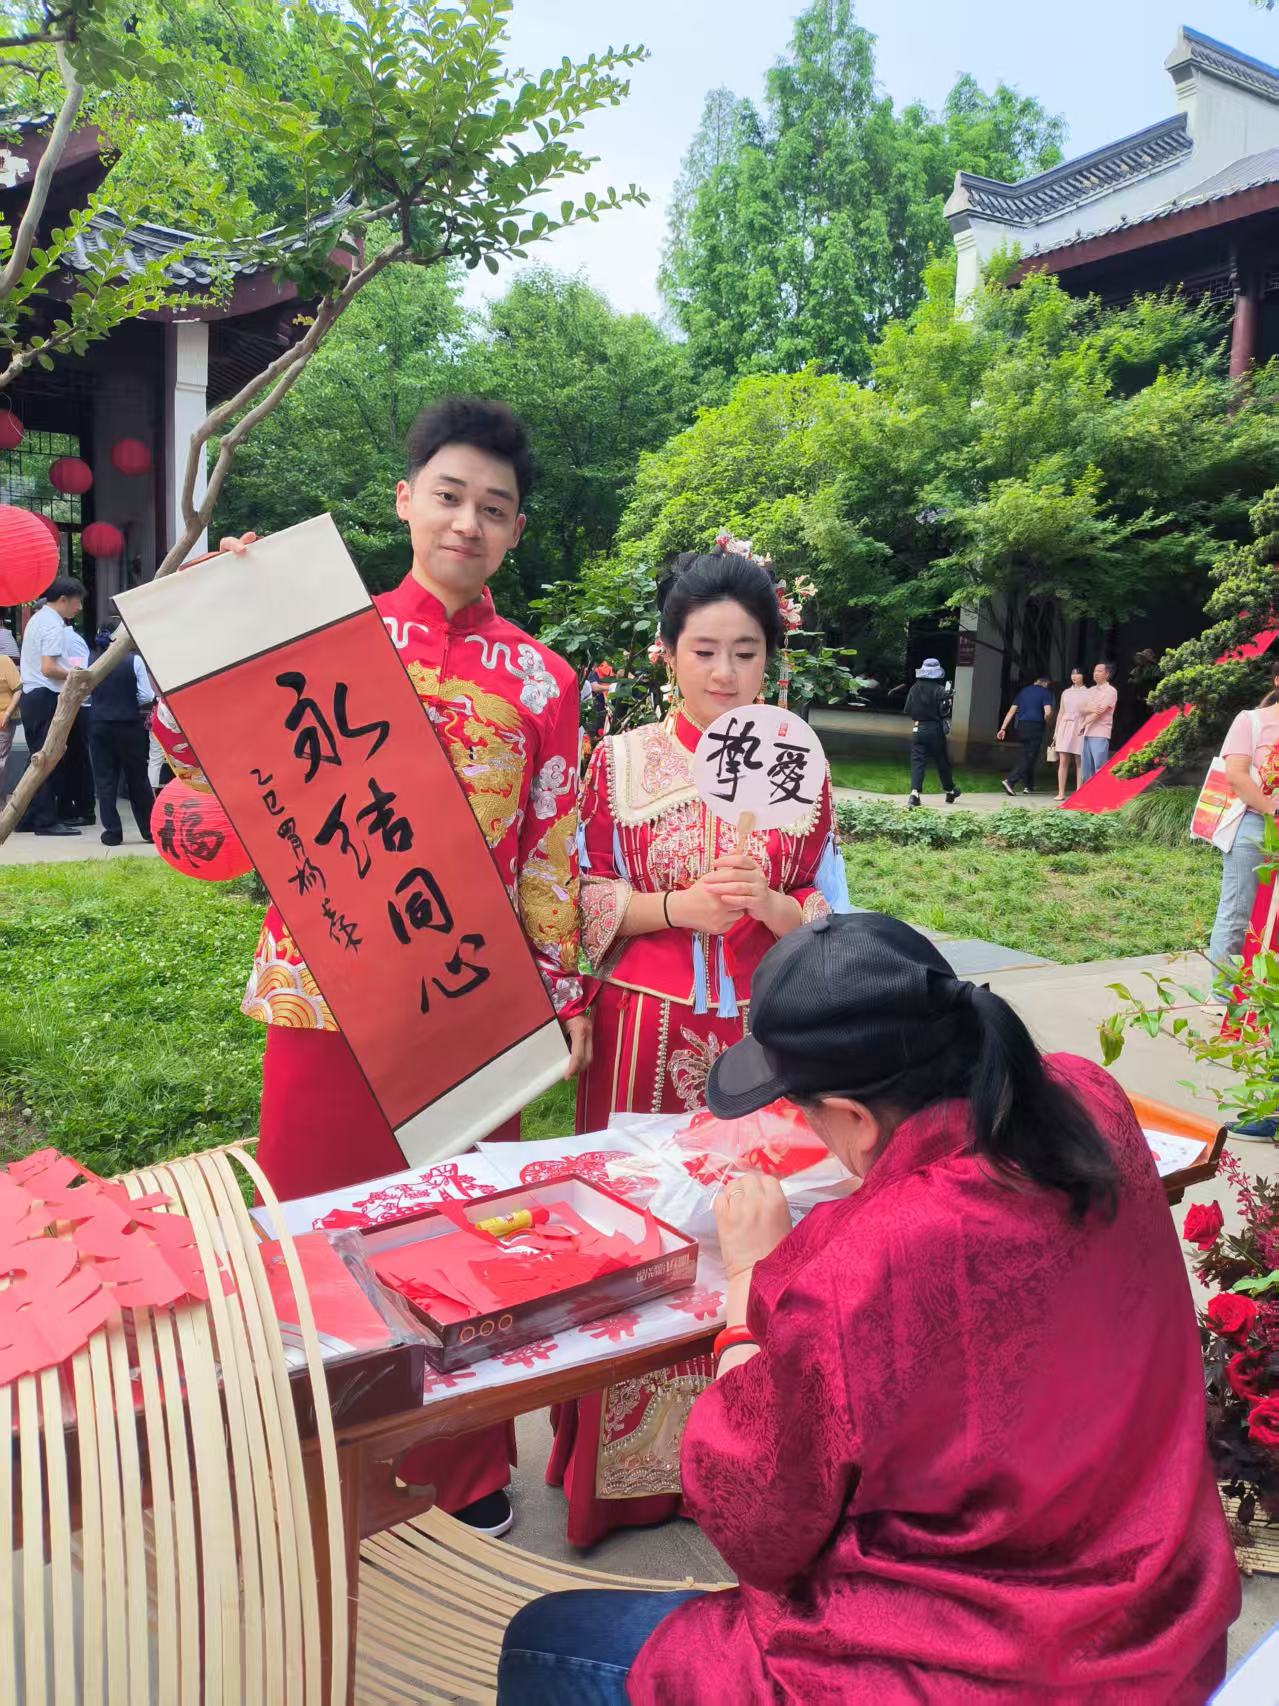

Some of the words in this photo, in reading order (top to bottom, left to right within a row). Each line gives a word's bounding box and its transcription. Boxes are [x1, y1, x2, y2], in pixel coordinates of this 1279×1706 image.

[157, 798, 225, 868] 福
[275, 671, 491, 1014] 永结同心
